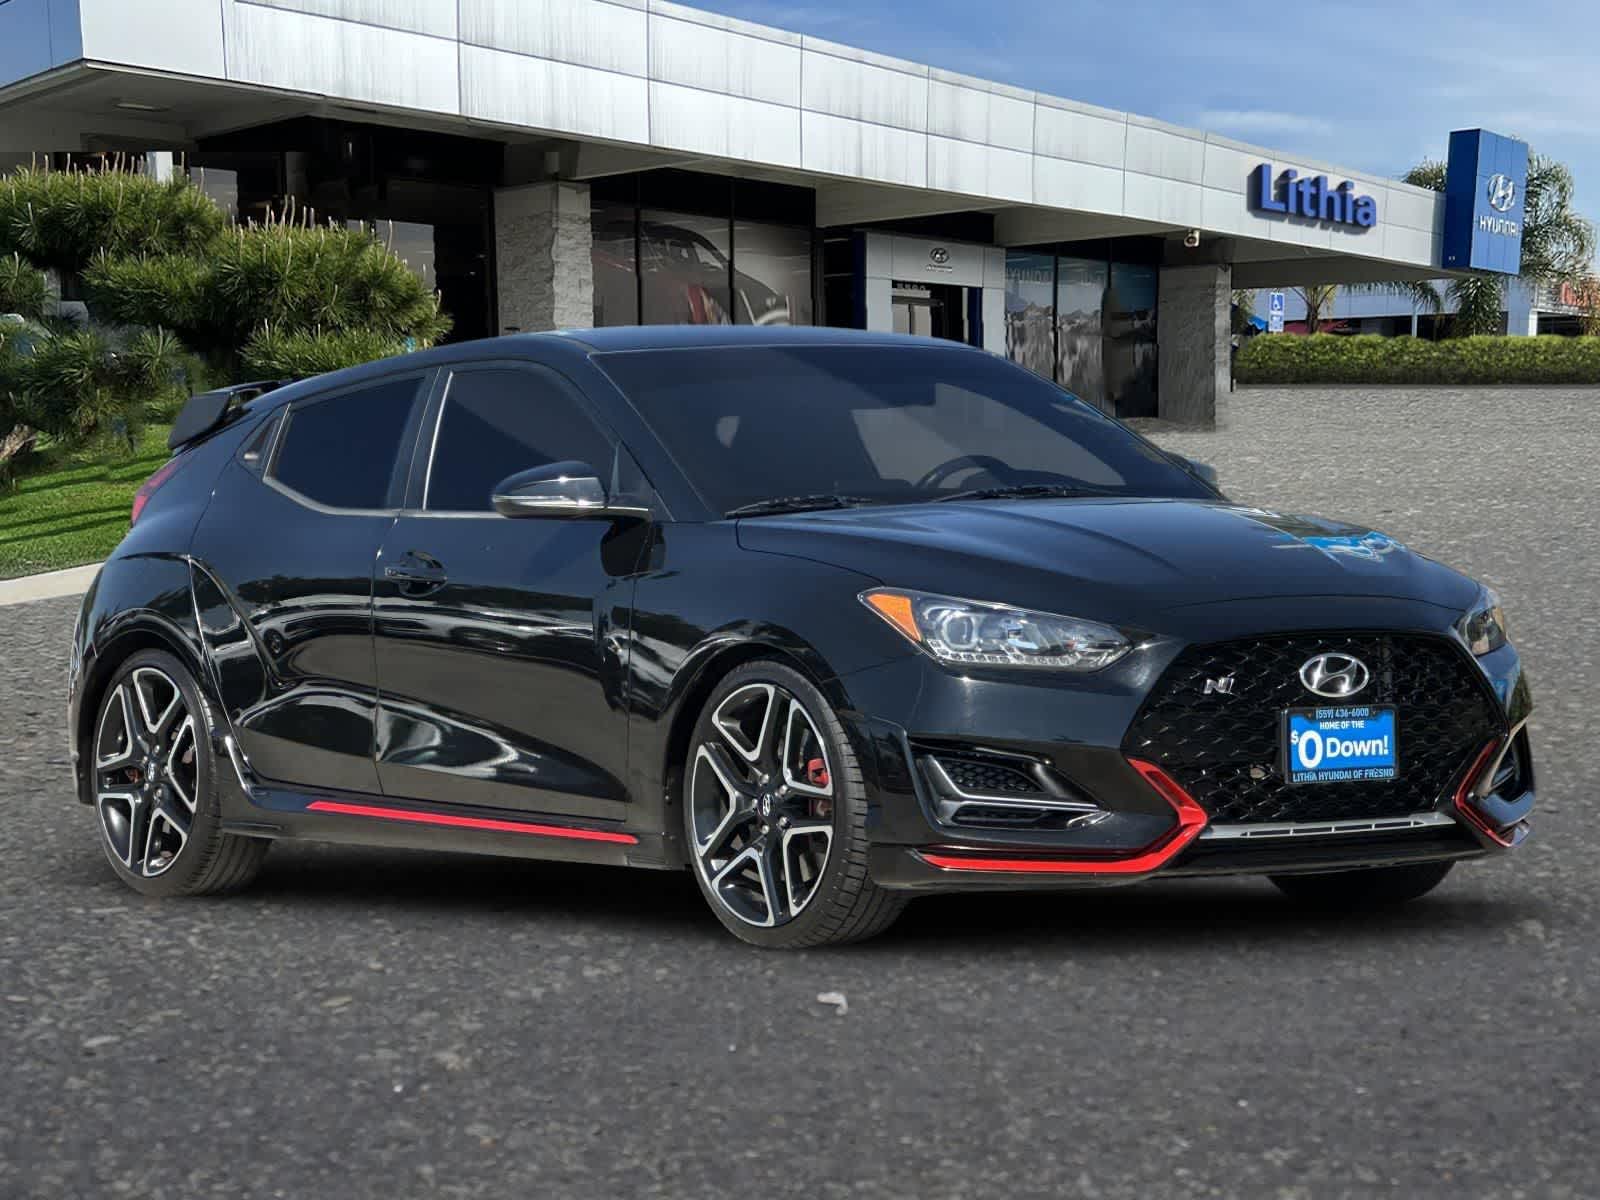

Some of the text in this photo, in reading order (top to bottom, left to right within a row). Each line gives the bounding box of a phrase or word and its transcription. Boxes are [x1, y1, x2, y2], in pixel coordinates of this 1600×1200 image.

[1256, 163, 1376, 228] Lithia
[1479, 215, 1519, 237] HYUNDAI
[1315, 707, 1369, 719] (559) 436-6000
[1320, 720, 1365, 730] HOME OF THE
[1290, 730, 1389, 769] $0 Down!
[1292, 768, 1394, 782] LITHIA HYUNDAI OF FRESNO
